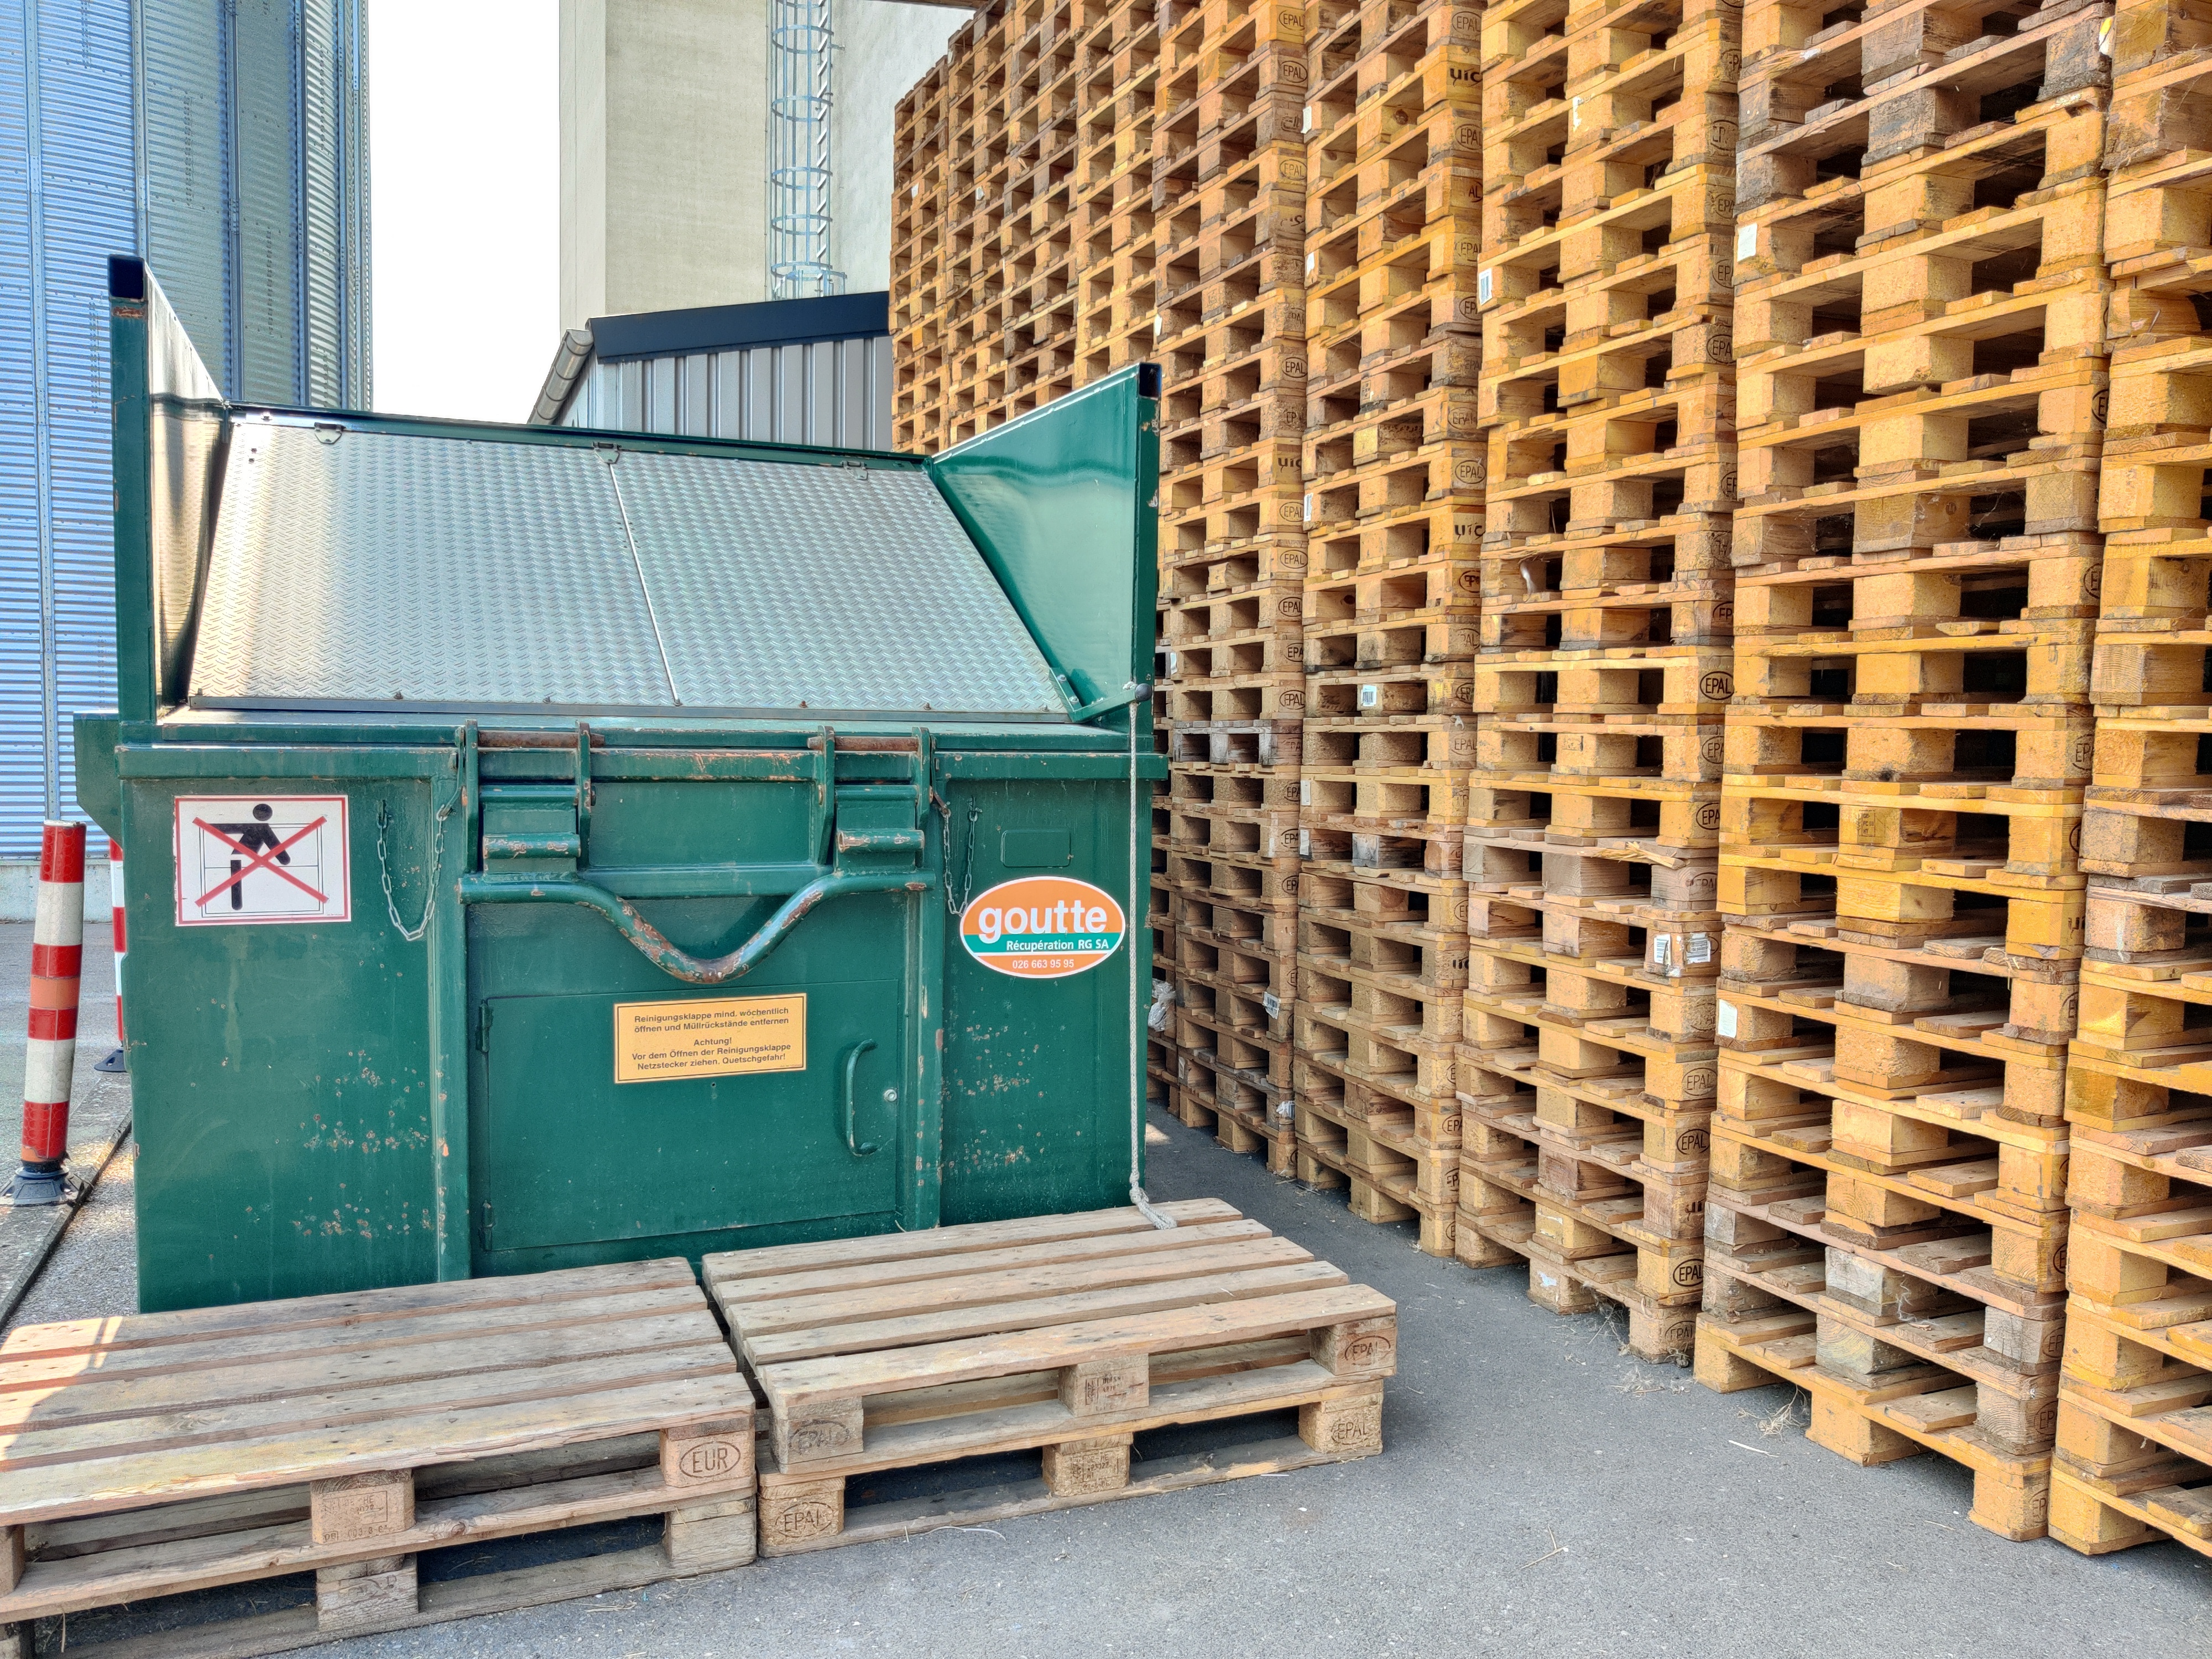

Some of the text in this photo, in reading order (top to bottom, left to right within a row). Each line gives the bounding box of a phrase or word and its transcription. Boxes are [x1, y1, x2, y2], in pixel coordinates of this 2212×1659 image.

[1283, 13, 1304, 27] EPAL
[1457, 17, 1481, 32] EPAL
[1283, 64, 1304, 79] EPAL
[1450, 67, 1483, 87] uic
[1284, 163, 1303, 177] EPAL
[1718, 199, 1735, 212] EPA
[1712, 340, 1732, 356] EPA
[1285, 361, 1305, 375] EPAL
[1460, 465, 1482, 478] EPAL
[1284, 554, 1305, 565] EPAL
[1283, 601, 1302, 613] EPAL
[1287, 648, 1303, 659] EPA
[1705, 677, 1731, 694] EPAL
[1284, 693, 1305, 707] EPAL
[1707, 741, 1724, 758] EPA
[1287, 786, 1301, 797] EPA
[1703, 810, 1720, 825] EPA
[1285, 833, 1298, 844] EPA
[979, 900, 1107, 943] goutte
[1006, 940, 1109, 952] Récupération RG SA
[1013, 959, 1074, 969] 026 663 95 95
[634, 1007, 789, 1023] Reinigungsklappe mind. wöchentlich
[634, 1024, 662, 1032] öffnen
[684, 1020, 748, 1030] Müllrückstände
[750, 1018, 789, 1026] entfernen
[694, 1037, 732, 1046] Achtung!
[649, 1051, 667, 1060] dem
[670, 1049, 698, 1057] Öffnen
[717, 1044, 791, 1055] Reinigungsklappe
[638, 1061, 688, 1070] Netzstecker
[722, 1054, 786, 1064] Quetschgefahr!
[1686, 1074, 1712, 1091] EPAL
[1681, 1135, 1707, 1151] EPAL
[1679, 1265, 1703, 1282] EPAL
[1337, 1422, 1370, 1440] EPAL
[692, 1447, 728, 1474] EUR
[784, 1509, 830, 1533] EPAL
